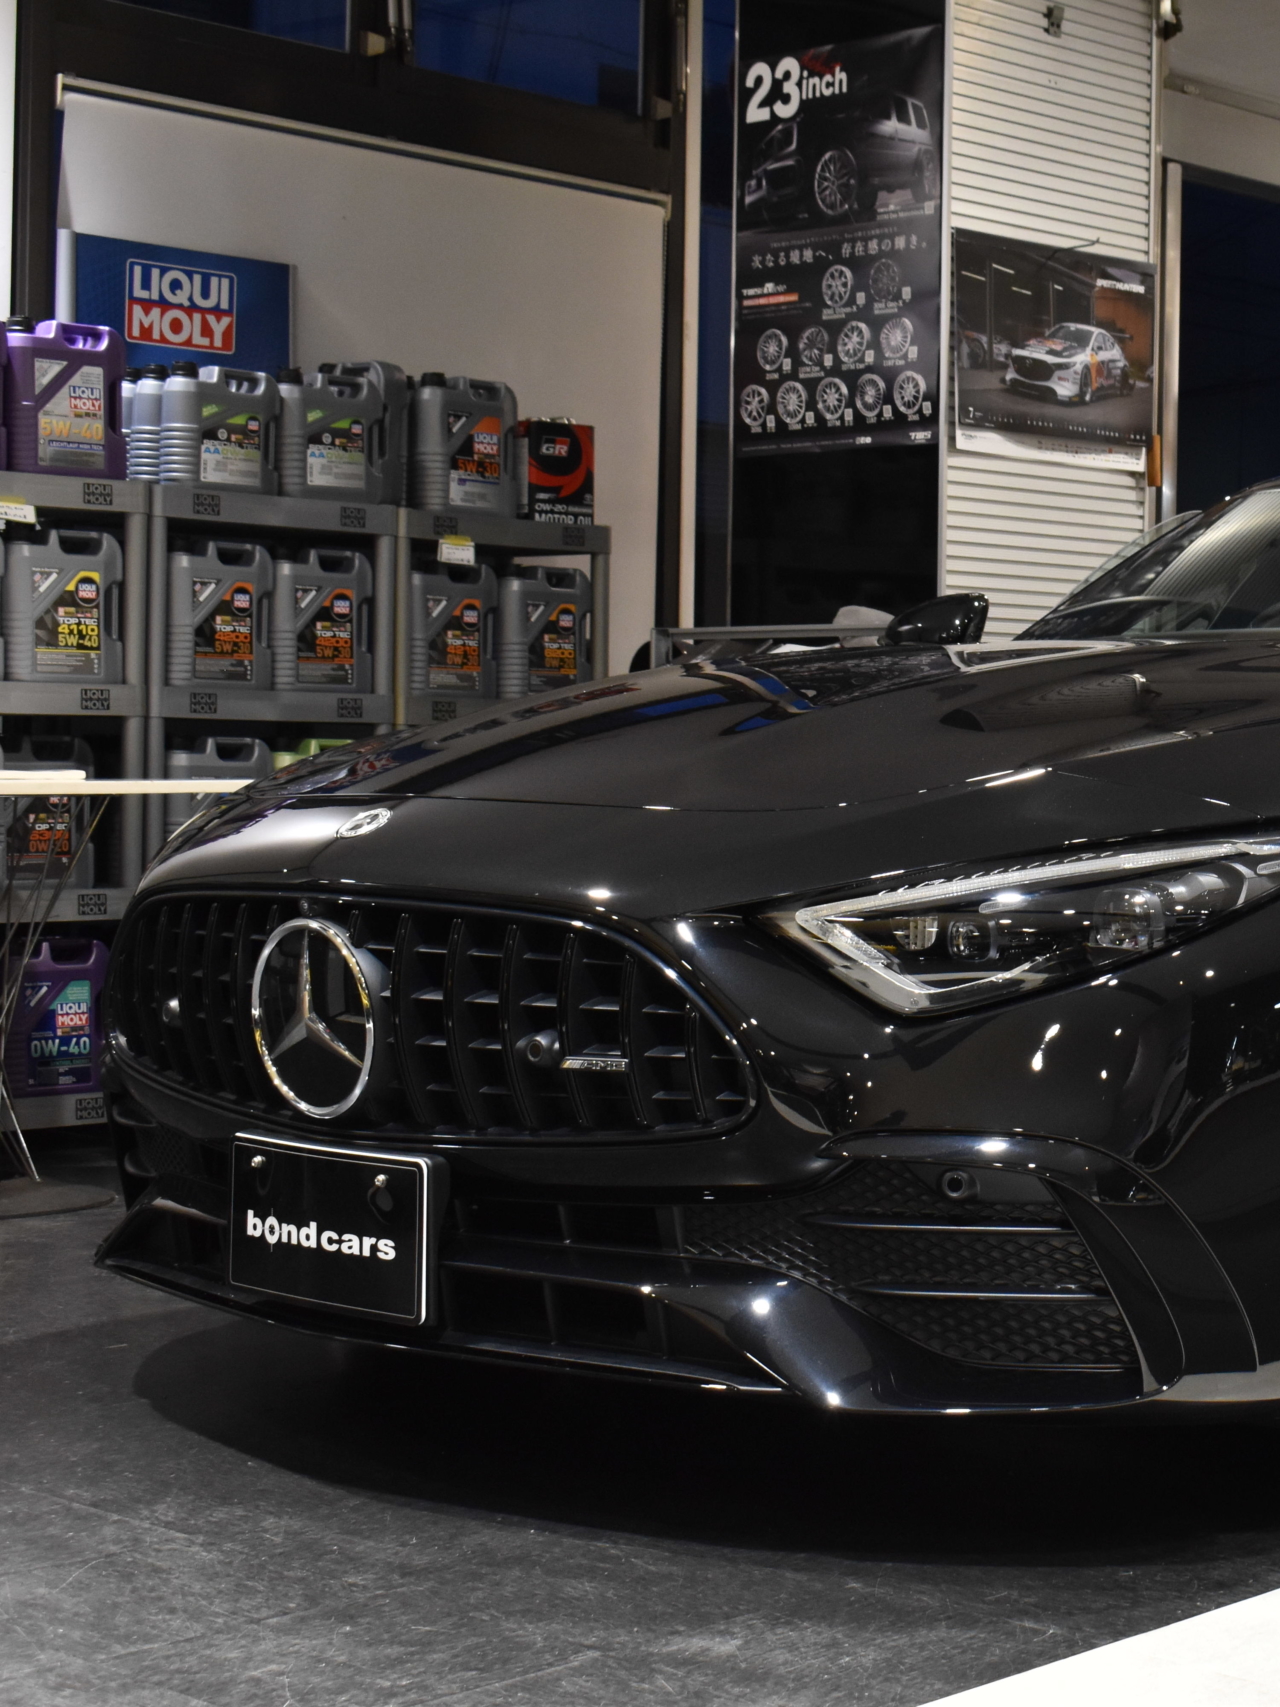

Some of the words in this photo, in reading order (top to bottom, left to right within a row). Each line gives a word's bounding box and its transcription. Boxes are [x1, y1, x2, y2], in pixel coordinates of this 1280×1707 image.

[745, 56, 801, 124] 23
[801, 65, 848, 100] inch
[132, 265, 230, 310] LIQUI
[132, 304, 233, 348] MOLY
[70, 387, 100, 398] LIQUI
[70, 399, 101, 410] MOLY
[41, 418, 103, 440] 5W-40
[474, 433, 498, 444] LIQUI
[474, 444, 499, 454] MOLY
[542, 443, 568, 455] GR
[458, 459, 500, 476] 5W-30
[84, 483, 112, 494] LIQUI
[84, 494, 112, 504] MOLY
[194, 494, 220, 505] LIQUI
[194, 505, 220, 516] MOLY
[341, 507, 366, 517] LIQUI
[535, 502, 567, 512] 0W-20
[341, 517, 366, 528] MOLY
[58, 624, 98, 635] 4110
[58, 634, 98, 647] 5W-40
[215, 633, 250, 641] 4200
[316, 638, 350, 647] 4200
[215, 641, 250, 653] 5W-30
[316, 646, 351, 658] 5W-30
[447, 646, 478, 656] 4210
[81, 689, 109, 699] LIQUI
[190, 693, 217, 703] LIQUI
[81, 699, 109, 710] MOLY
[190, 703, 217, 713] MOLY
[338, 698, 362, 707] LIQUI
[338, 707, 362, 718] MOLY
[78, 894, 107, 904] LIQUI
[78, 904, 107, 915] MOLY
[57, 1003, 87, 1014] LIQUI
[58, 1014, 89, 1025] MOLY
[31, 1036, 90, 1058] 0W-40
[77, 1098, 104, 1108] LIQUI
[77, 1108, 104, 1119] MOLY
[320, 1230, 397, 1260] cars
